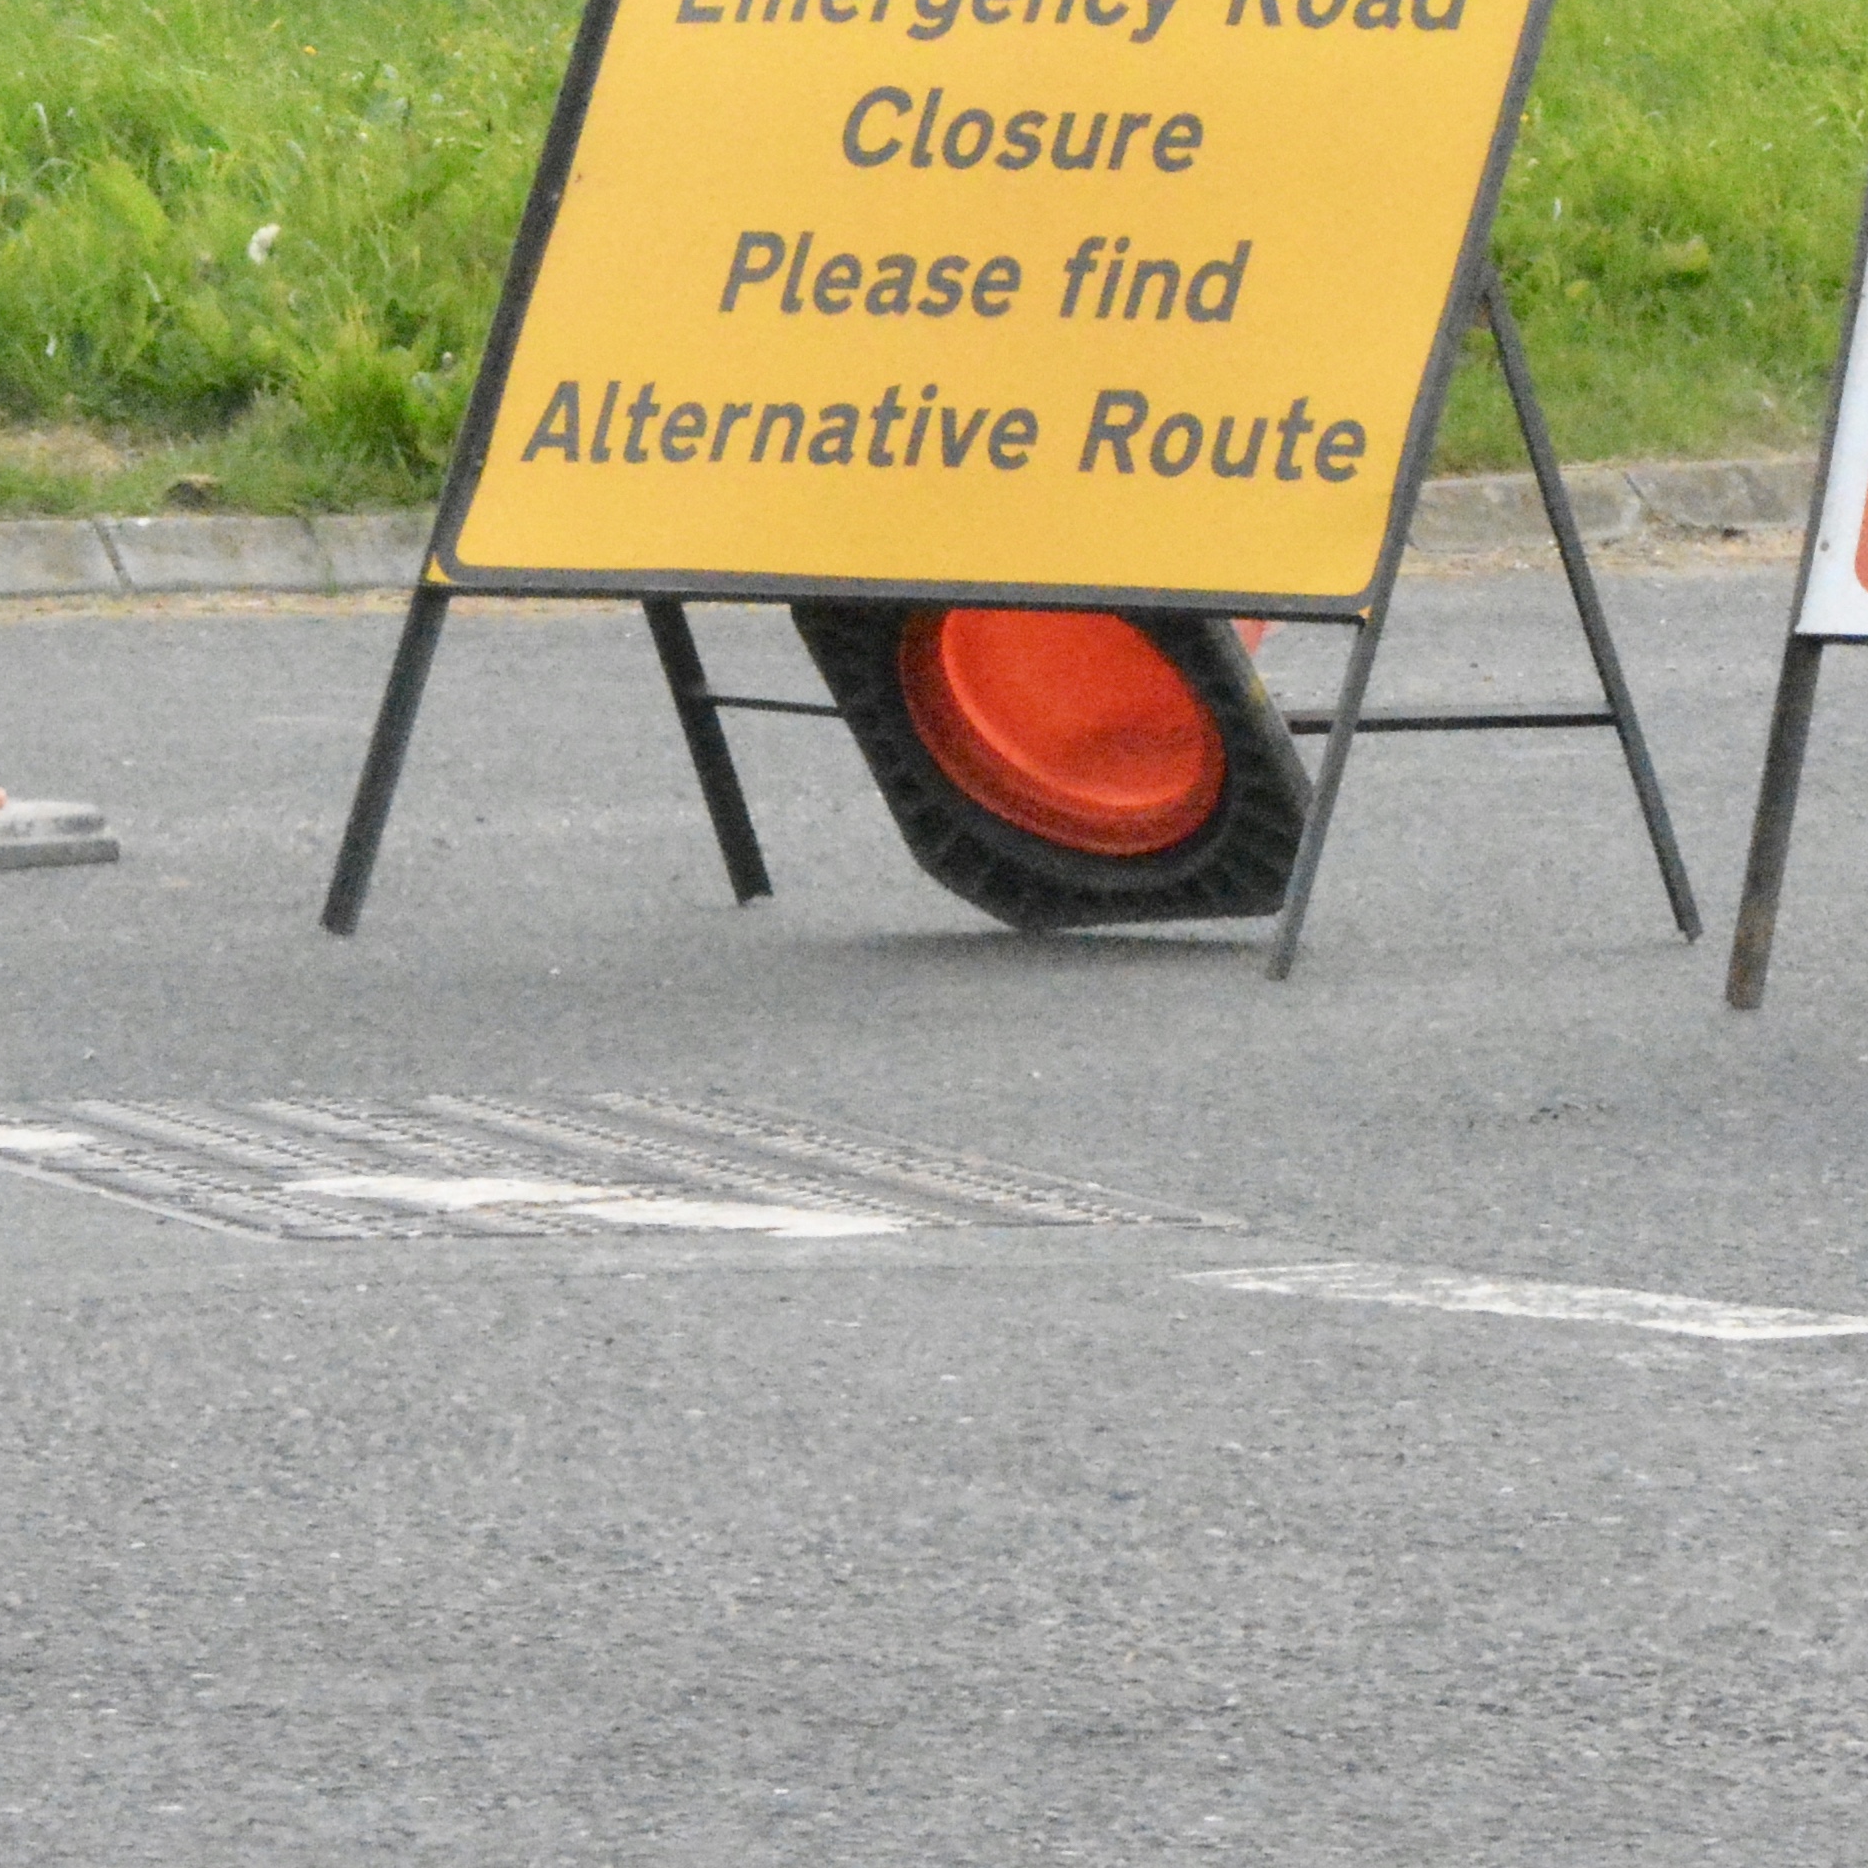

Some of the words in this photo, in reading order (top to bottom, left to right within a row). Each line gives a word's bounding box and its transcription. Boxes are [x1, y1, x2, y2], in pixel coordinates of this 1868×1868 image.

[842, 86, 1203, 173] Closure
[720, 232, 1021, 318] Please
[1060, 236, 1252, 323] find
[521, 381, 1038, 471] Alternative
[1078, 389, 1366, 482] Route
